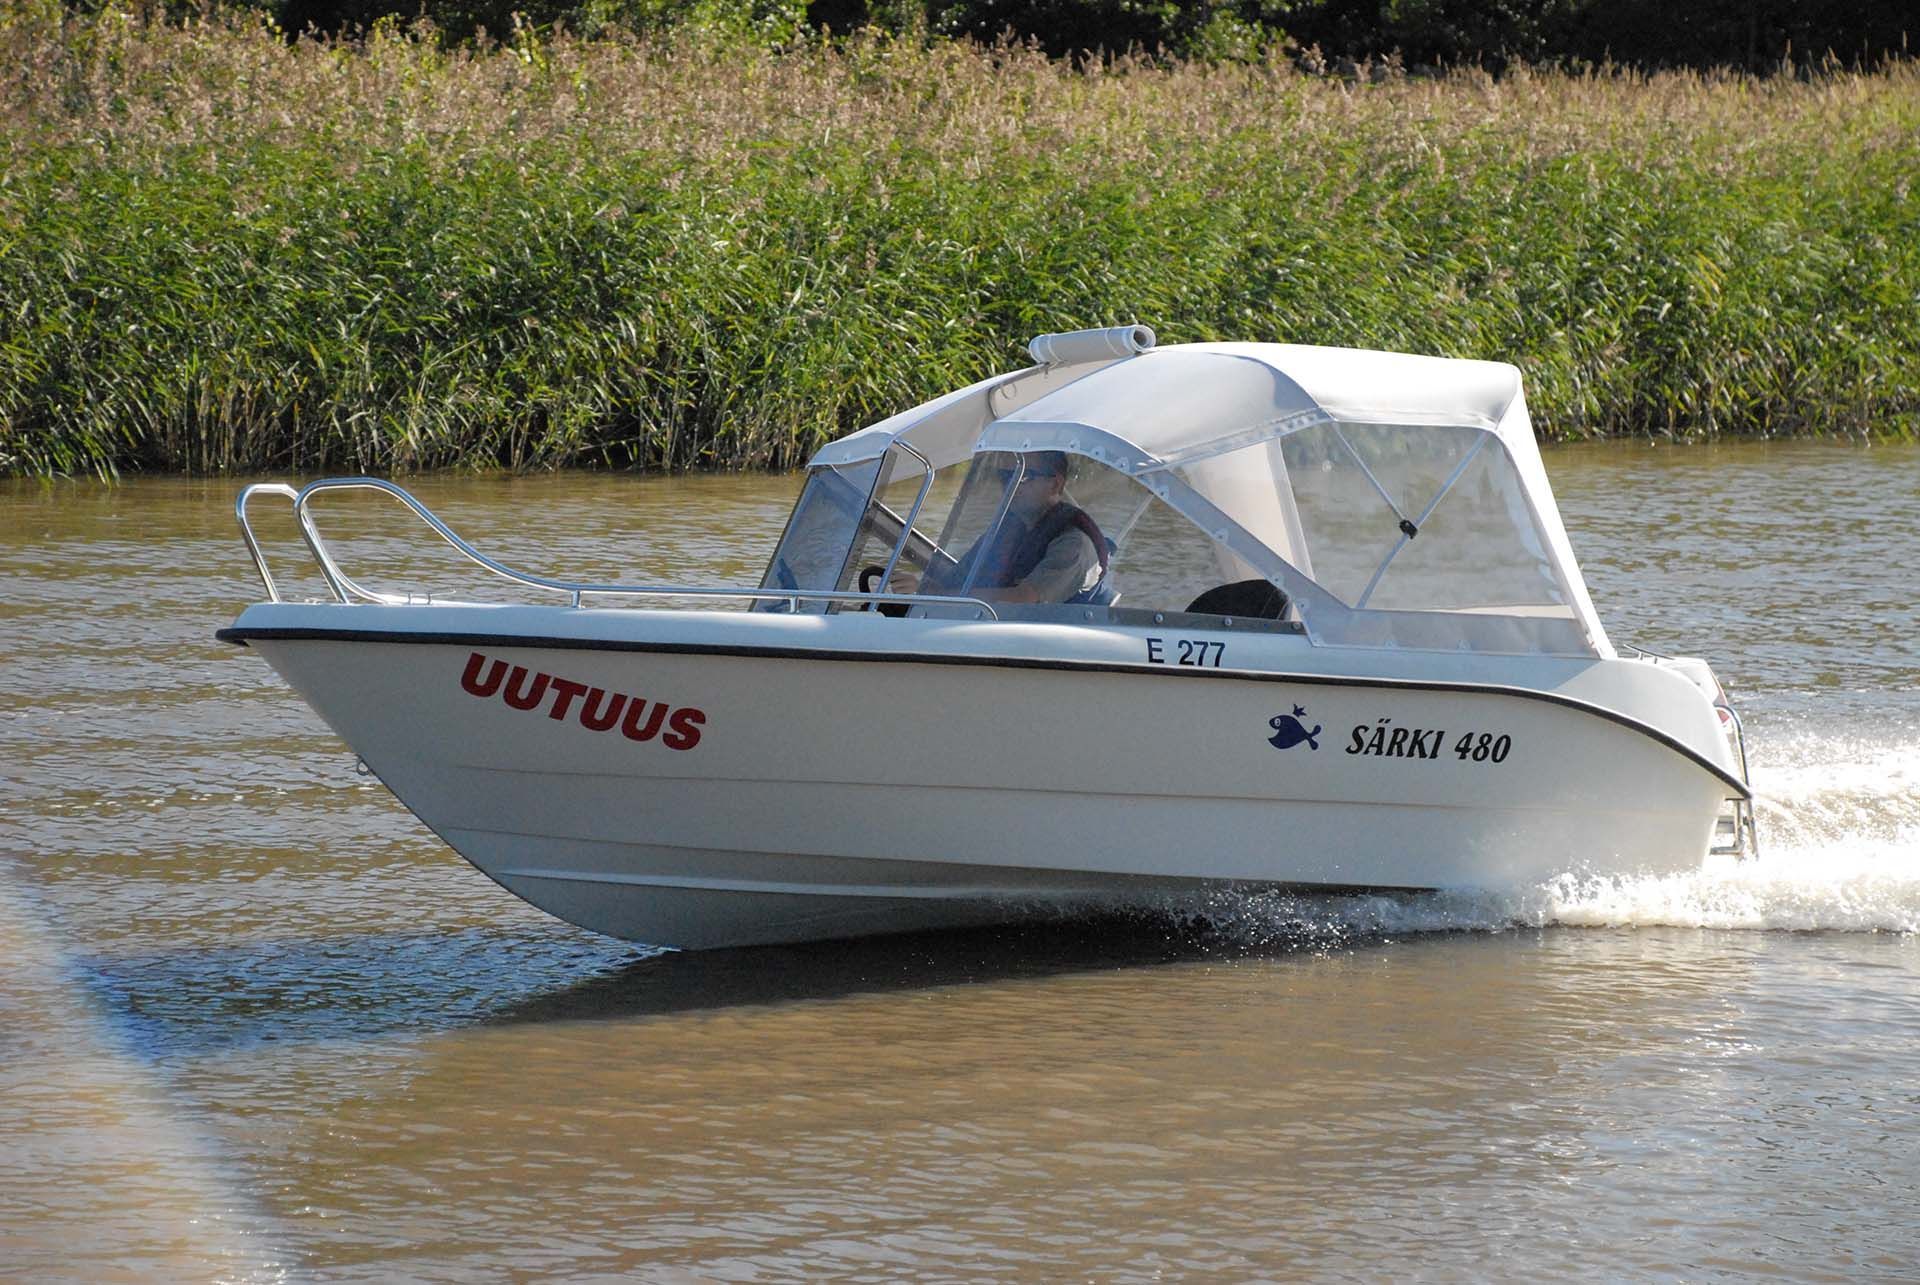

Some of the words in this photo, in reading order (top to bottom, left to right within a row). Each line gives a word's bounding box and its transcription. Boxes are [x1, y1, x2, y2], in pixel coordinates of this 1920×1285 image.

[1146, 637, 1164, 664] E
[1177, 639, 1226, 668] 277
[460, 652, 707, 750] UUTUUS
[1345, 718, 1445, 760] SÄRKI
[1454, 731, 1512, 763] 480
